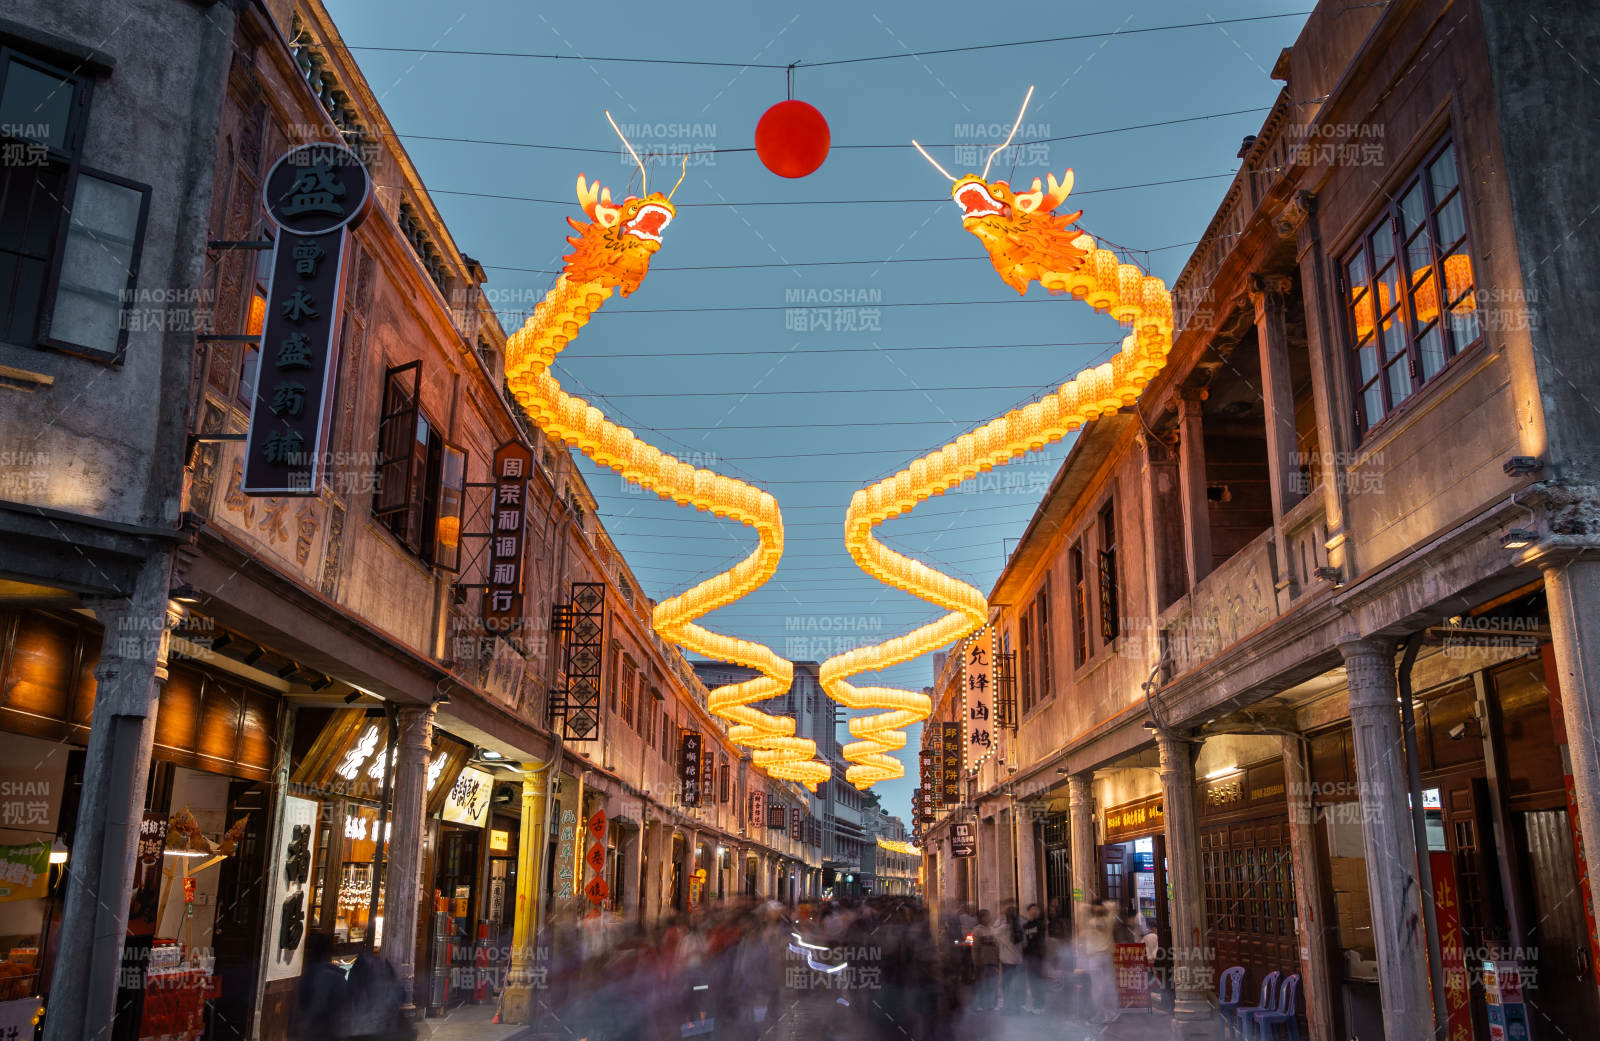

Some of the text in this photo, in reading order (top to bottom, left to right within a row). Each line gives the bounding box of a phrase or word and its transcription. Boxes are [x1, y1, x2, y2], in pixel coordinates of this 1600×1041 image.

[281, 158, 346, 217] 盛
[263, 240, 325, 466] 曾永盛药铺
[491, 458, 523, 612] 周荣和调和行
[968, 646, 991, 749] 允锋卤鹅
